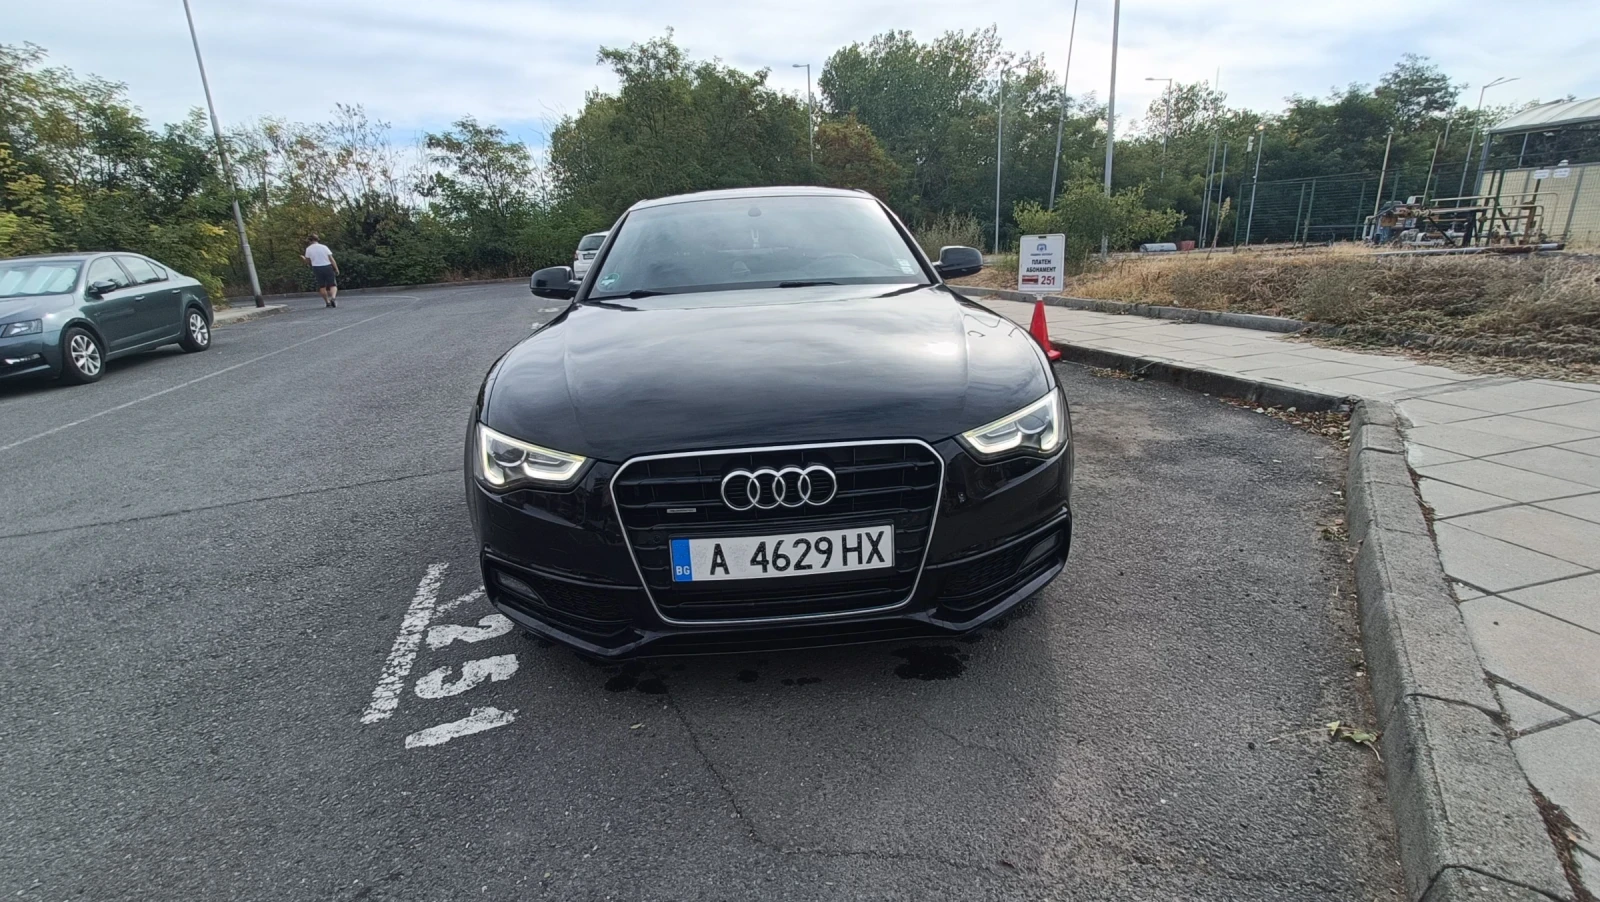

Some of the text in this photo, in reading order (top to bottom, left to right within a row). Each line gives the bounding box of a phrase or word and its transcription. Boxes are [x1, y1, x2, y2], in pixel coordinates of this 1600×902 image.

[1040, 275, 1055, 286] 251
[709, 531, 885, 575] A 4629 HX
[676, 565, 690, 576] BG
